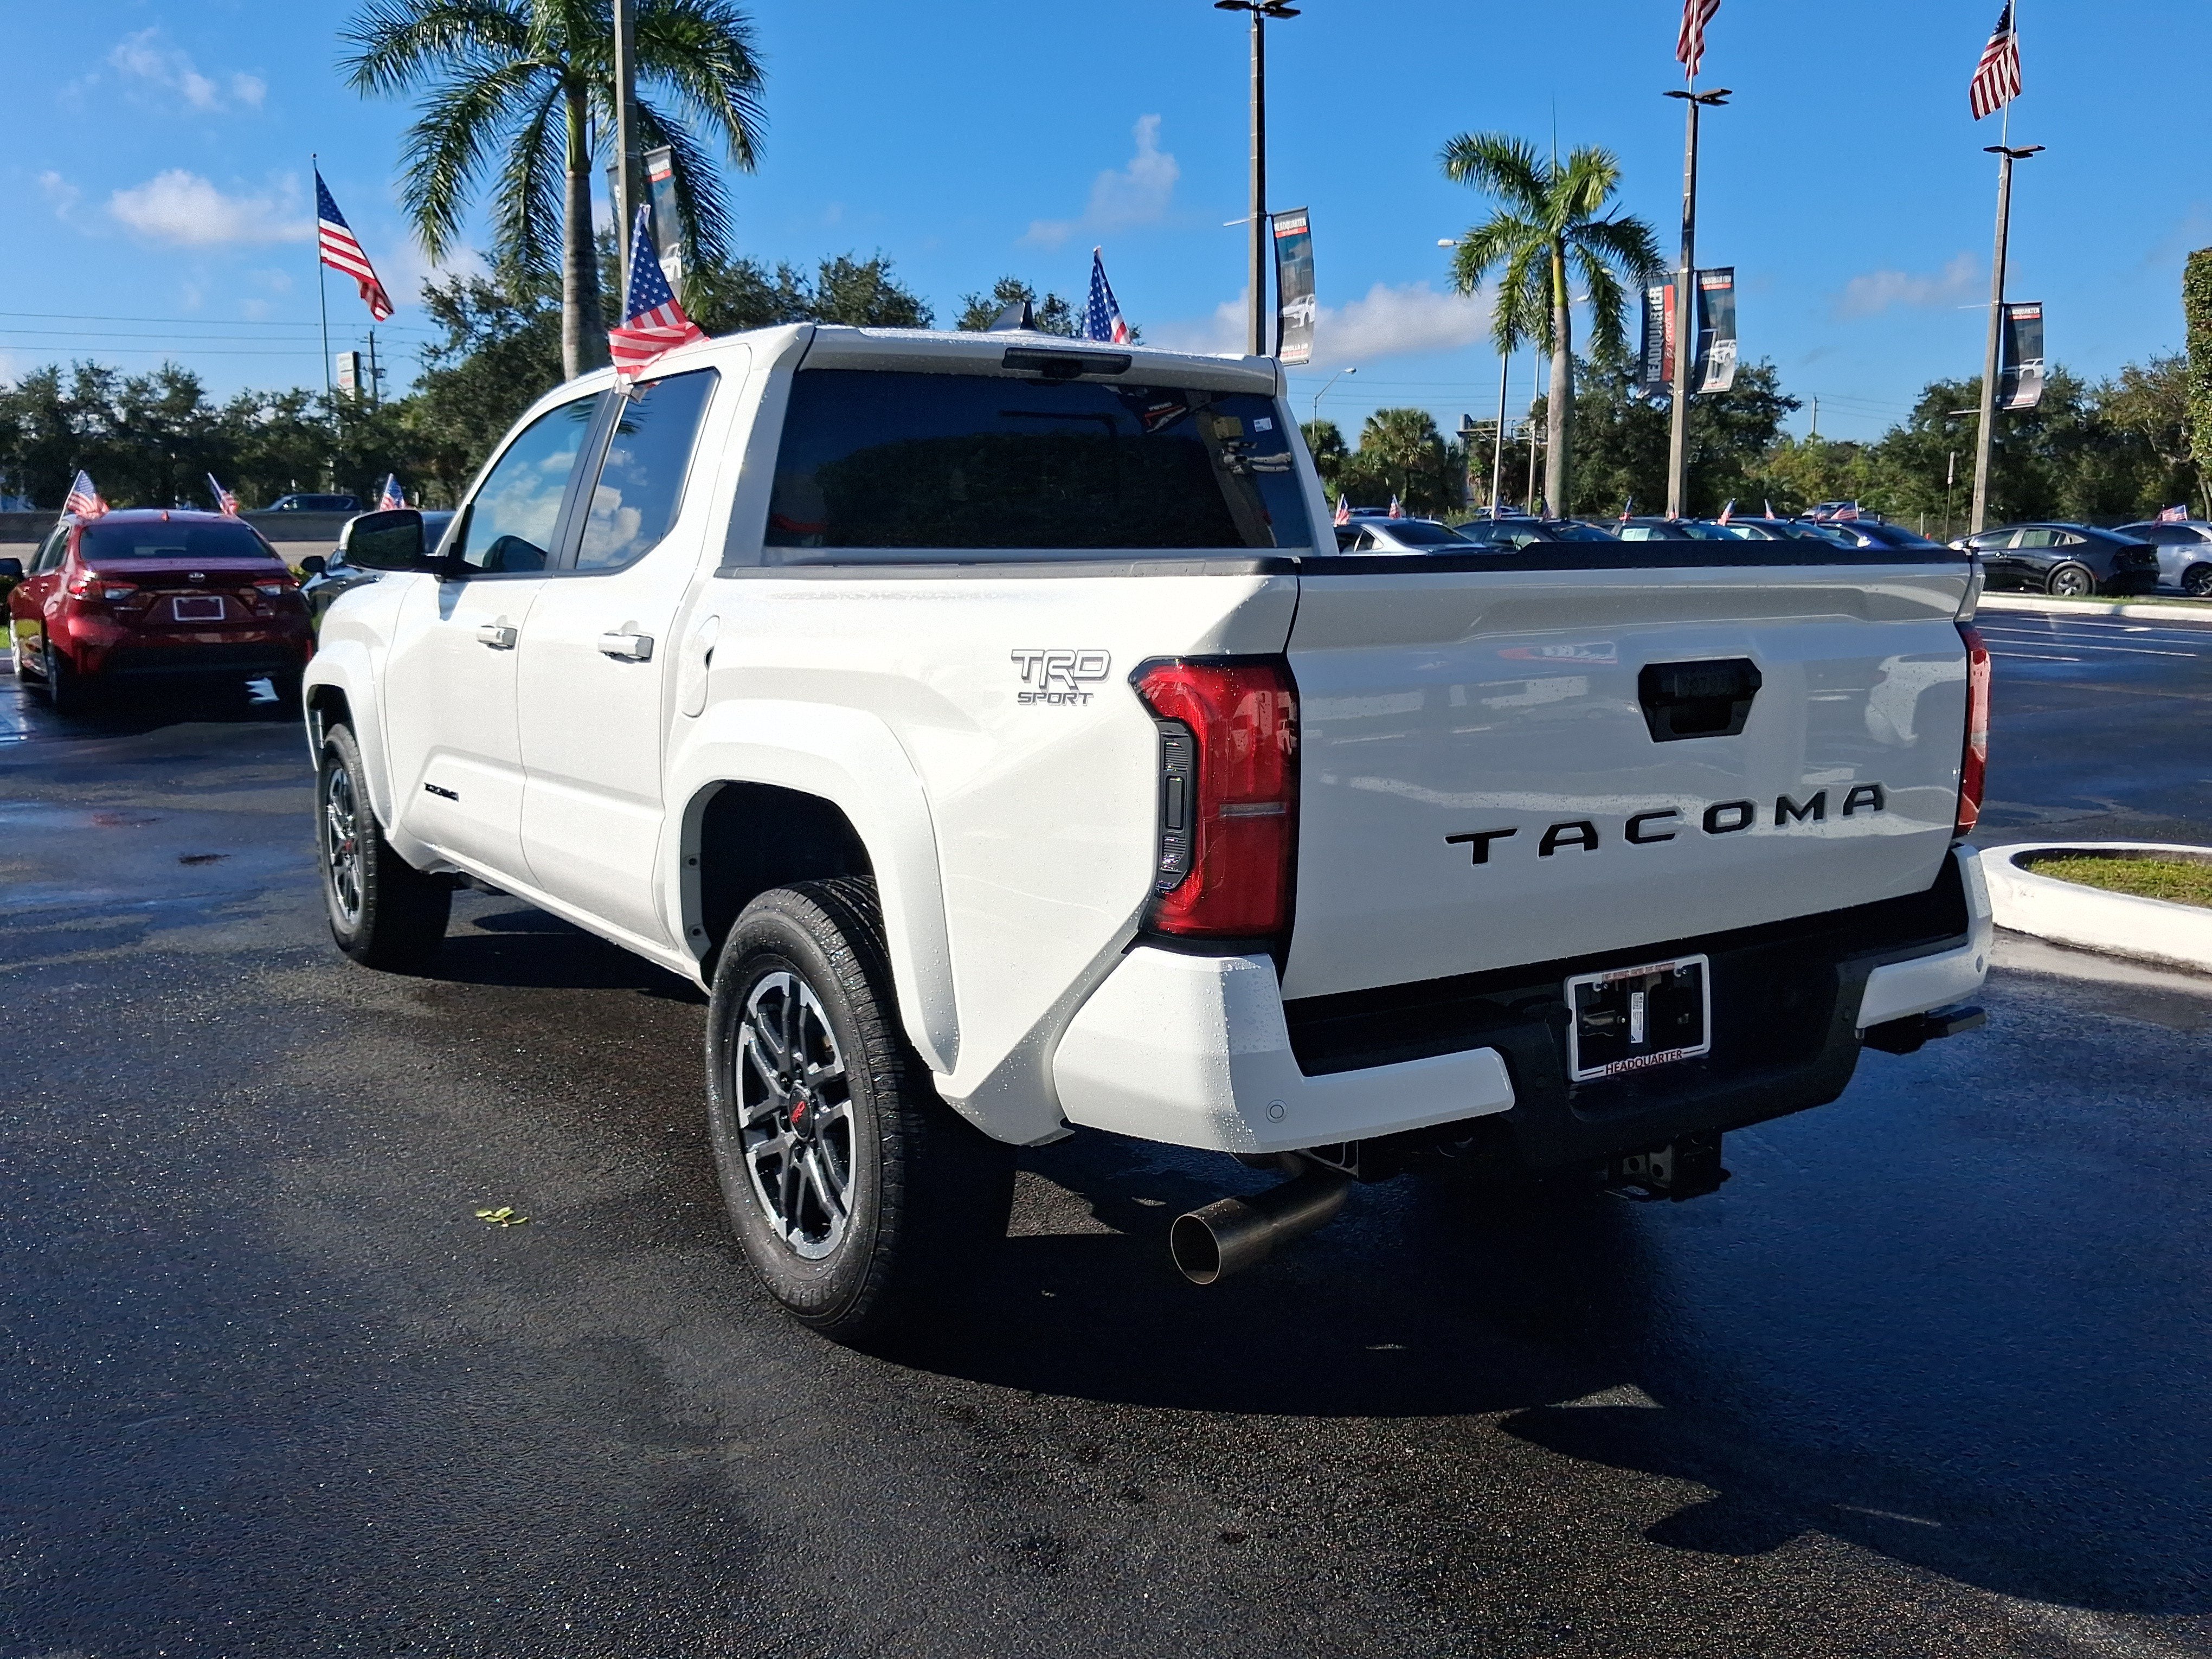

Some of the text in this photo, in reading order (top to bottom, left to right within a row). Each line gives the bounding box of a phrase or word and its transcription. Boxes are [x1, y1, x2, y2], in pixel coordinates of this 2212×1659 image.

[1647, 286, 1663, 383] HEADQUARTER
[1011, 649, 1111, 692] TRD
[1017, 692, 1094, 706] SPORT
[1444, 783, 1886, 866] TACOMA
[1605, 1050, 1682, 1075] HEADQUARTER
